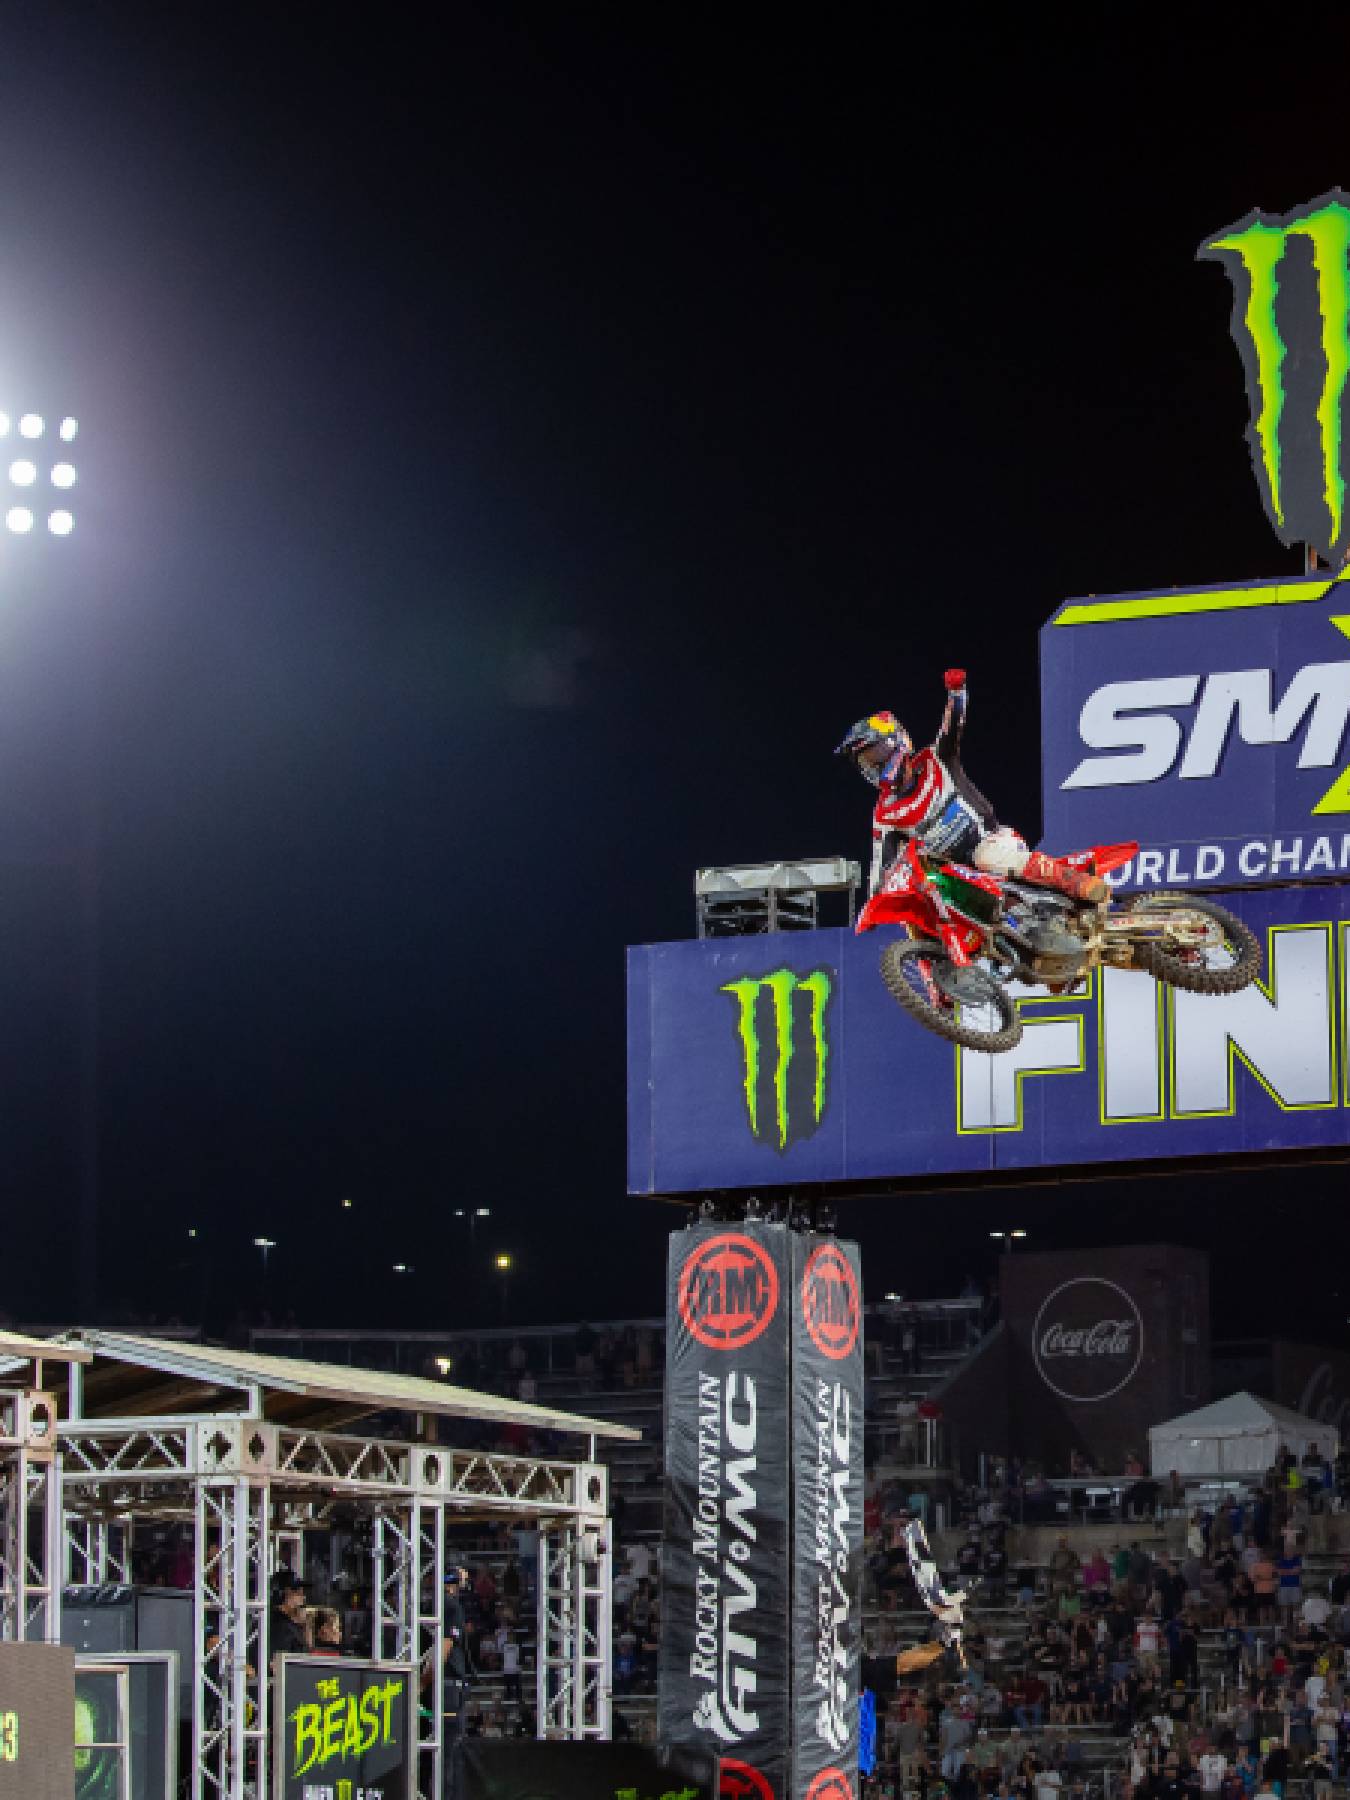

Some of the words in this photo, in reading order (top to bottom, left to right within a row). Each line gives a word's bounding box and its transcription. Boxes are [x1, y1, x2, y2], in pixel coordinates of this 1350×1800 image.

[1103, 845, 1225, 887] ORLD
[1040, 1319, 1135, 1359] Coca-Cola
[692, 1370, 721, 1564] MOUNTAIN
[690, 1566, 720, 1684] ROCKY
[0, 1711, 18, 1762] 3
[288, 1677, 403, 1778] BEAST
